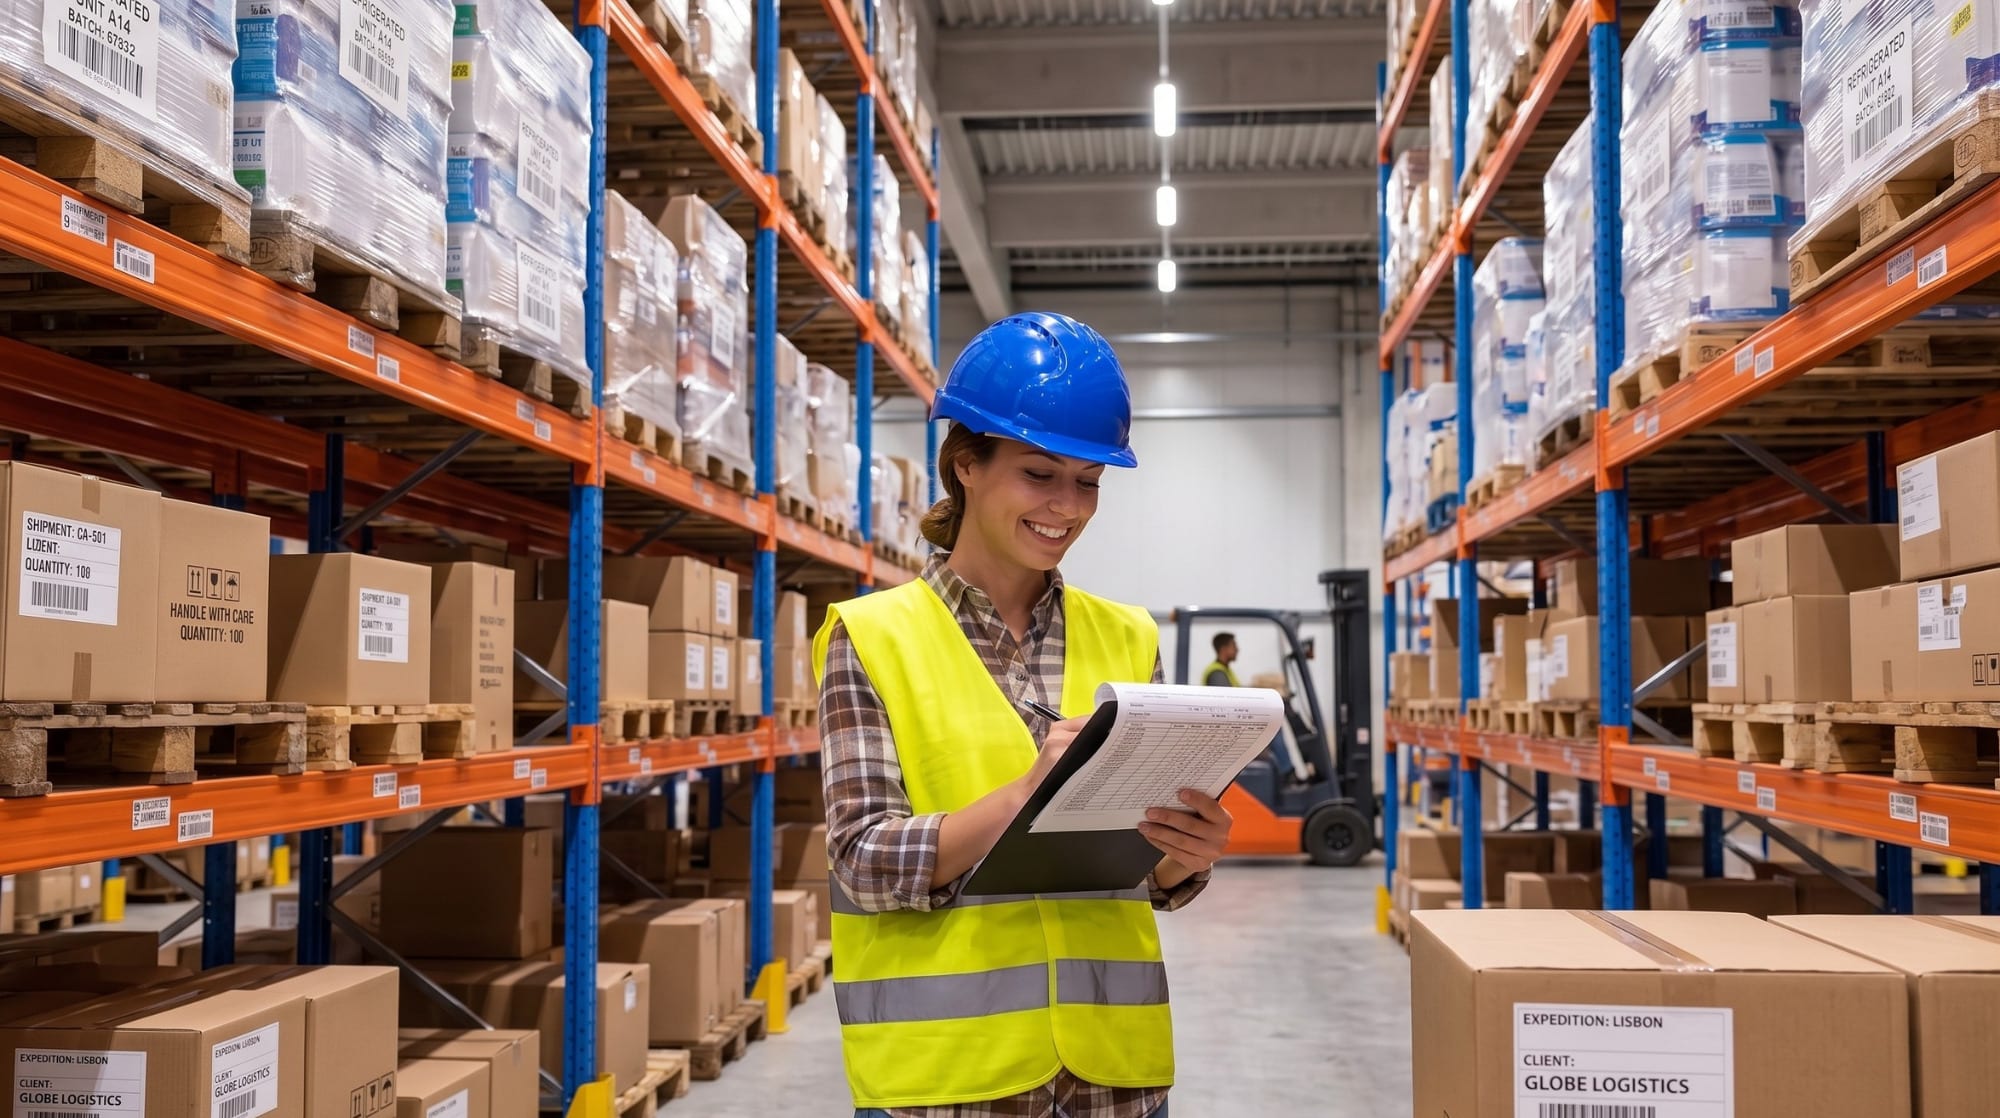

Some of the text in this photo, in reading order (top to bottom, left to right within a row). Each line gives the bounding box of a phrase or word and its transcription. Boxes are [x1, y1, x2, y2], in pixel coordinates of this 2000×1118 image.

[68, 7, 105, 40] BATCH:
[108, 9, 131, 35] A14
[359, 13, 377, 38] UNIT
[1847, 31, 1906, 93] REFRIGERATED
[1858, 65, 1892, 106] UNIT A14
[27, 517, 107, 545] SHIPMENT: CA-501
[25, 557, 73, 577] QUANTITY:
[170, 602, 255, 625] HANDLE WITH CARE
[180, 624, 244, 644] QUANTITY: 100
[1523, 1013, 1664, 1029] EXPEDITION: LISBON
[20, 1053, 109, 1066] EXPEDITION: LISBON
[1523, 1054, 1576, 1068] CLIENT:
[19, 1079, 53, 1089] CLIENT:
[214, 1066, 271, 1098] GLOBE LOGISTICS
[1524, 1075, 1690, 1095] GLOBE LOGISTICS
[19, 1092, 122, 1107] GLOBE LOGISTICS
